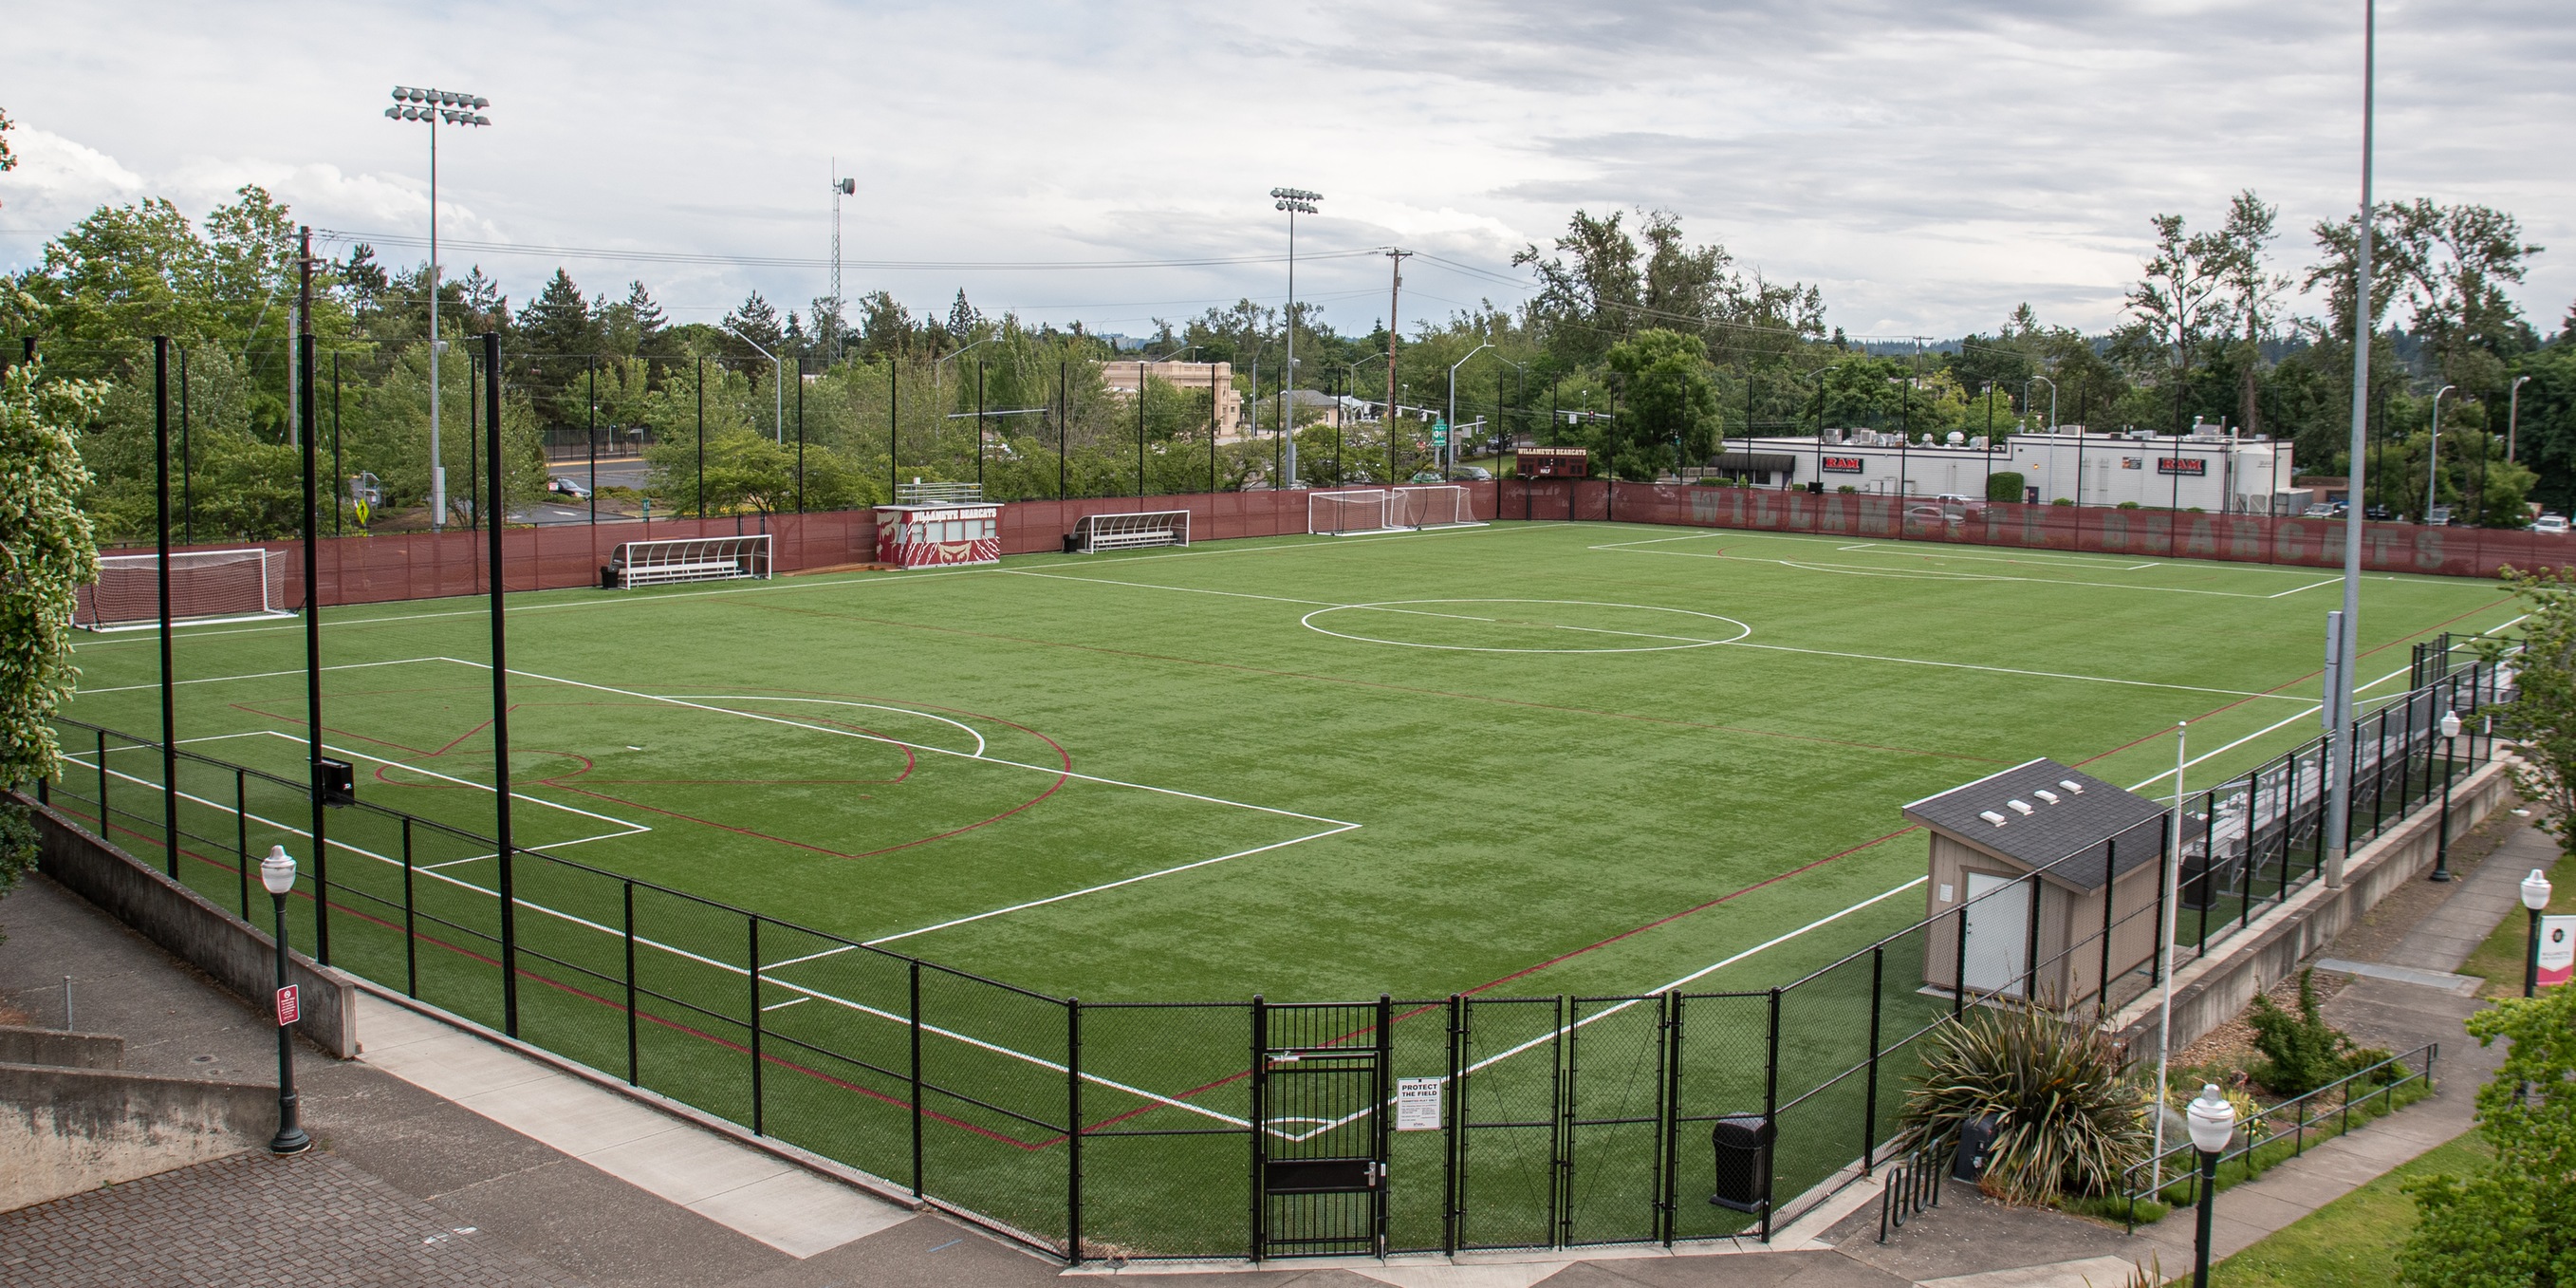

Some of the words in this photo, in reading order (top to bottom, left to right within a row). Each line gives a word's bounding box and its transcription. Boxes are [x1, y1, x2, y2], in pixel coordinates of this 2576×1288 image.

[1825, 457, 1859, 468] RAM
[2161, 458, 2201, 470] RAM
[912, 510, 958, 521] WILLAMETTE
[960, 508, 996, 518] BEARCATS
